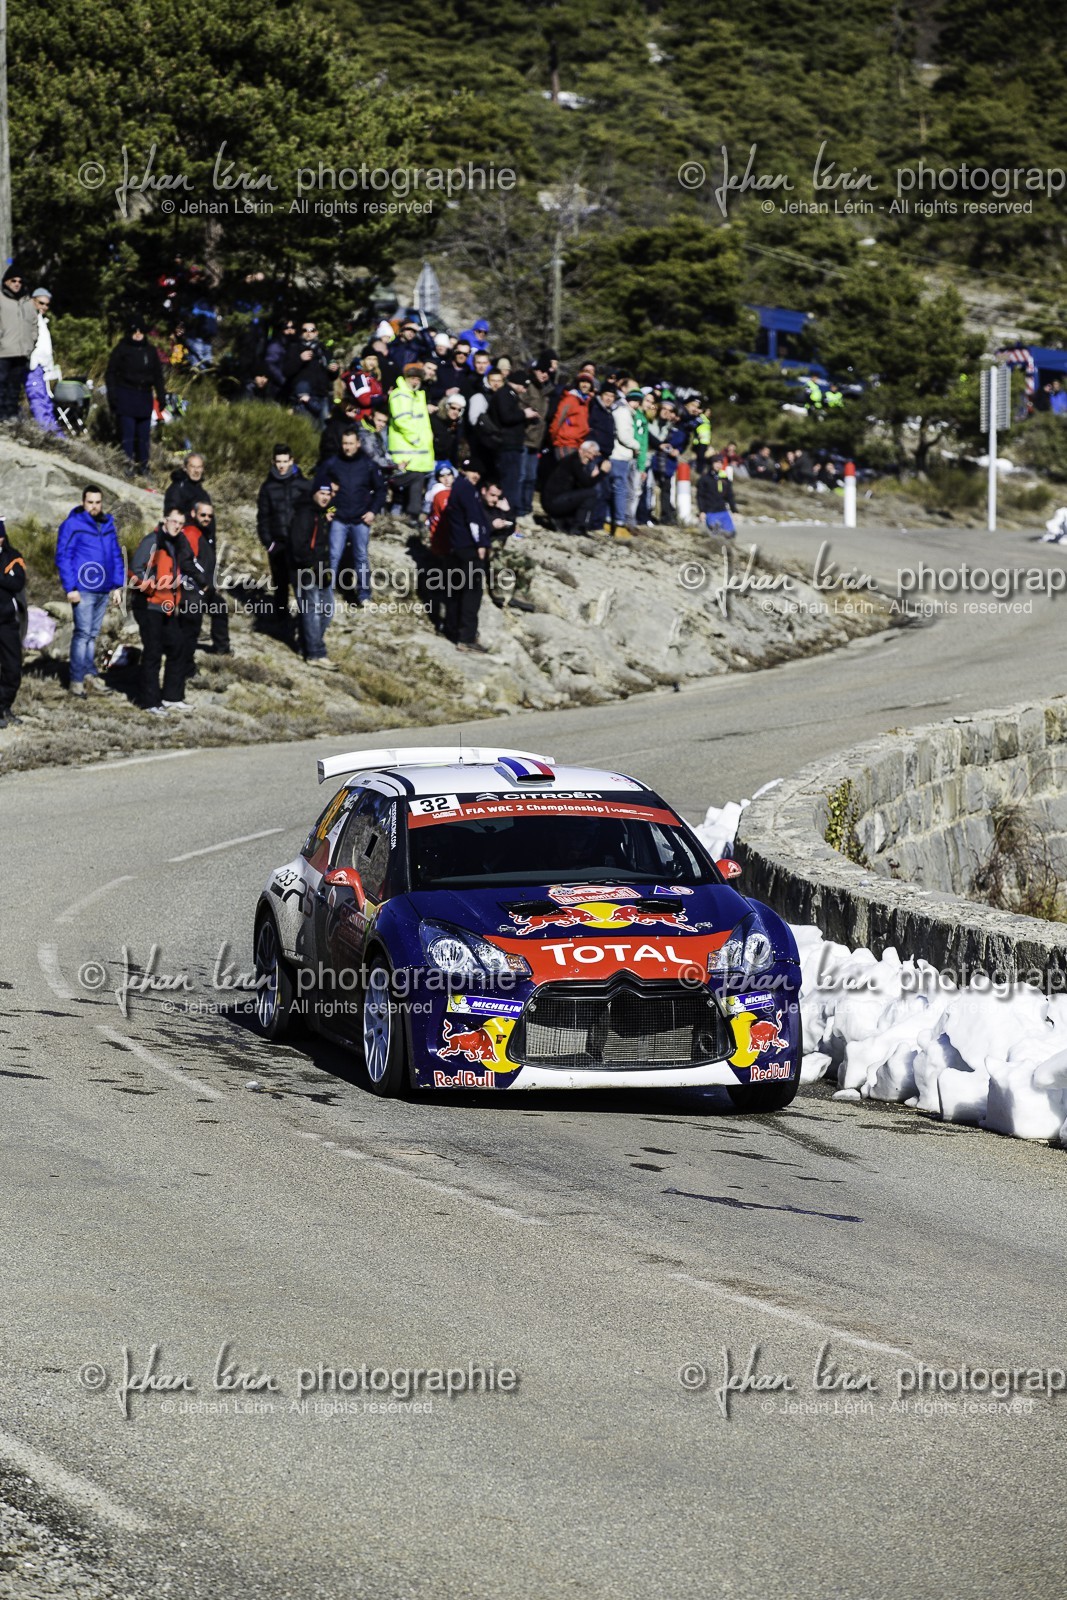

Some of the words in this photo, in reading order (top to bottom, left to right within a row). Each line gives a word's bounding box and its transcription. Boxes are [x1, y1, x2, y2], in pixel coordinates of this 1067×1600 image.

[420, 797, 450, 813] 32
[466, 807, 486, 815] FIA
[526, 804, 605, 813] Championship
[541, 943, 693, 966] TOTAL
[471, 1000, 521, 1013] MICHELIN
[434, 1070, 464, 1087] Red
[464, 1070, 496, 1087] Bull
